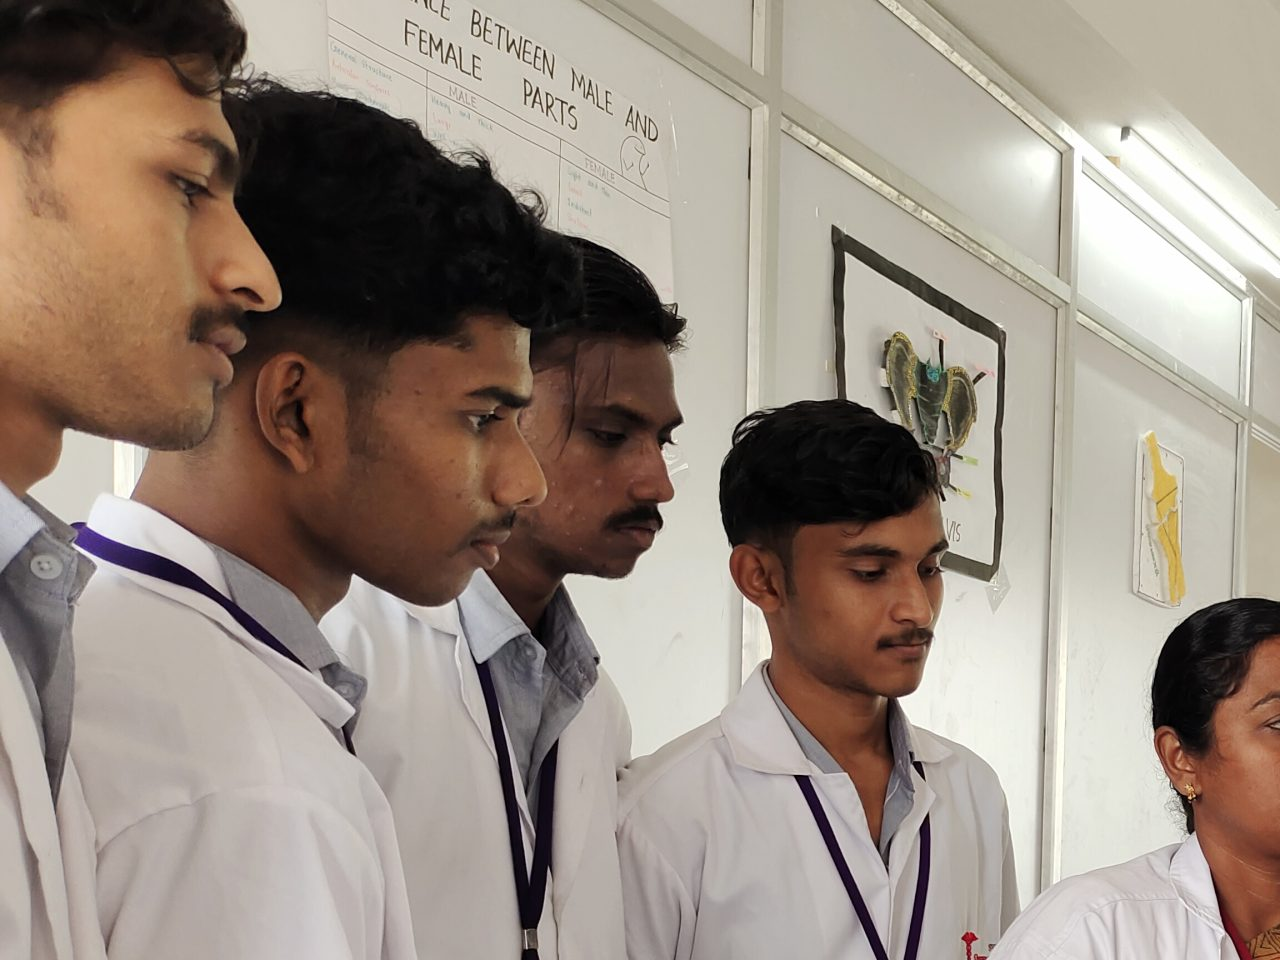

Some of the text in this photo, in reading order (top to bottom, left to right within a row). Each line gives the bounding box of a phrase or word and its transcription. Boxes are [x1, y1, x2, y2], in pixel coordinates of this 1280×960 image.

[404, 19, 578, 131] FEMALE PARTS
[470, 9, 555, 80] BETWEEN
[571, 67, 614, 116] MALE
[625, 105, 659, 142] AND
[449, 84, 477, 110] MALE
[584, 157, 615, 185] FEMALE
